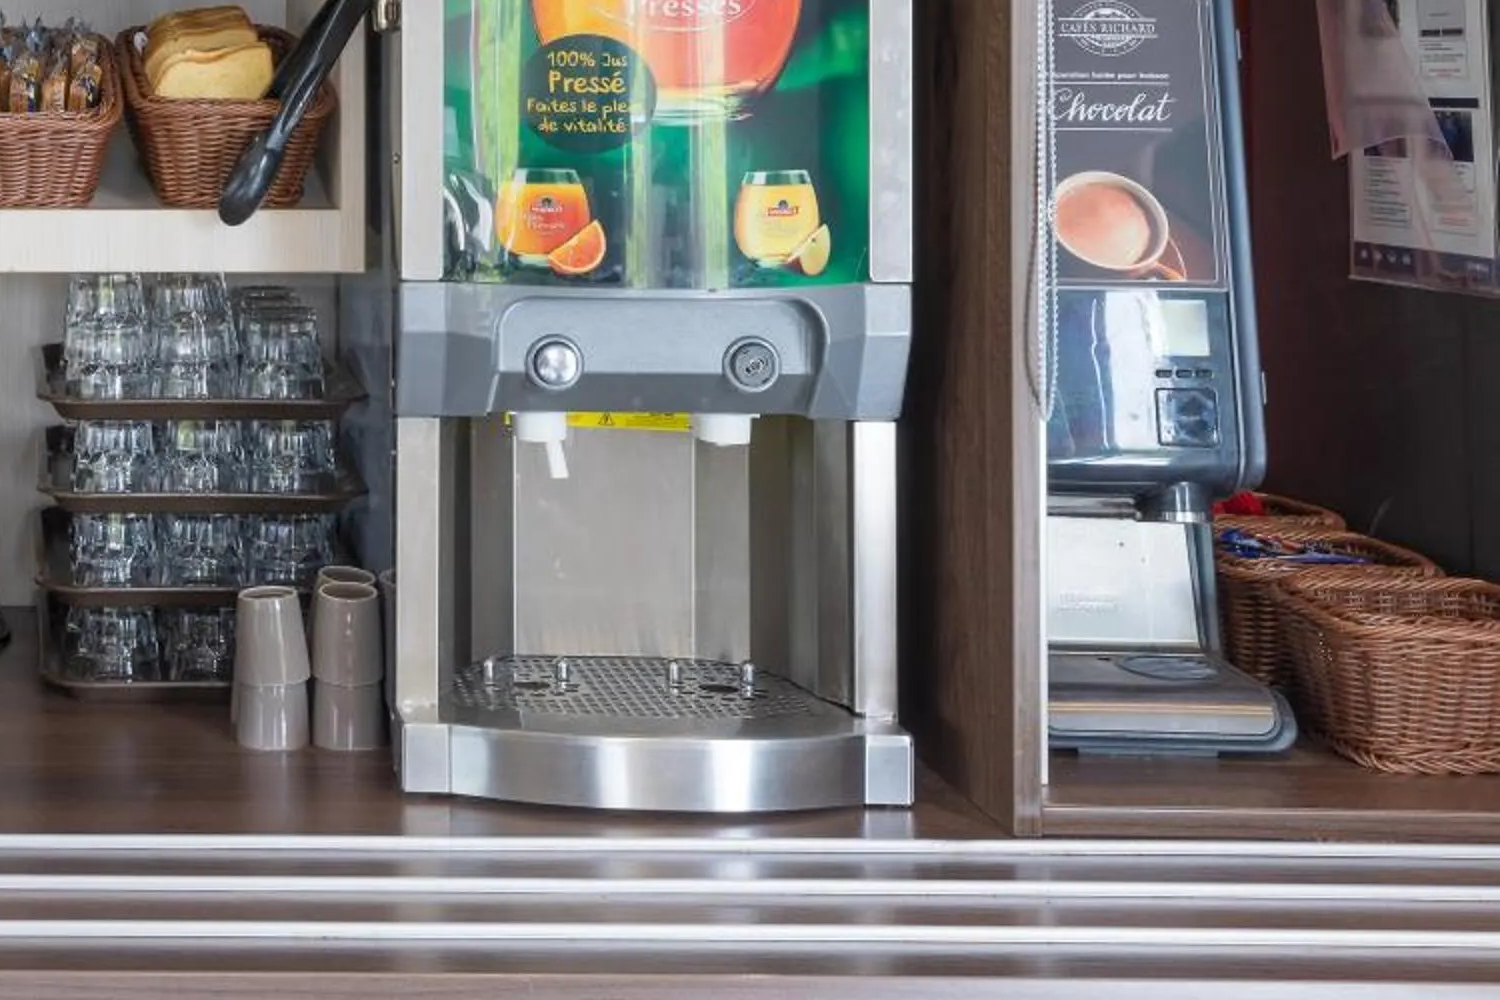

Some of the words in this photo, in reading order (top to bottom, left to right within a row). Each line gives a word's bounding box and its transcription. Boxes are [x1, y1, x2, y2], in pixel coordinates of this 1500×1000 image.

[547, 50, 597, 68] 100%
[601, 53, 629, 67] Jus
[548, 69, 627, 93] Pressé
[526, 97, 578, 113] Faites
[581, 99, 598, 113] le
[601, 99, 634, 119] ple
